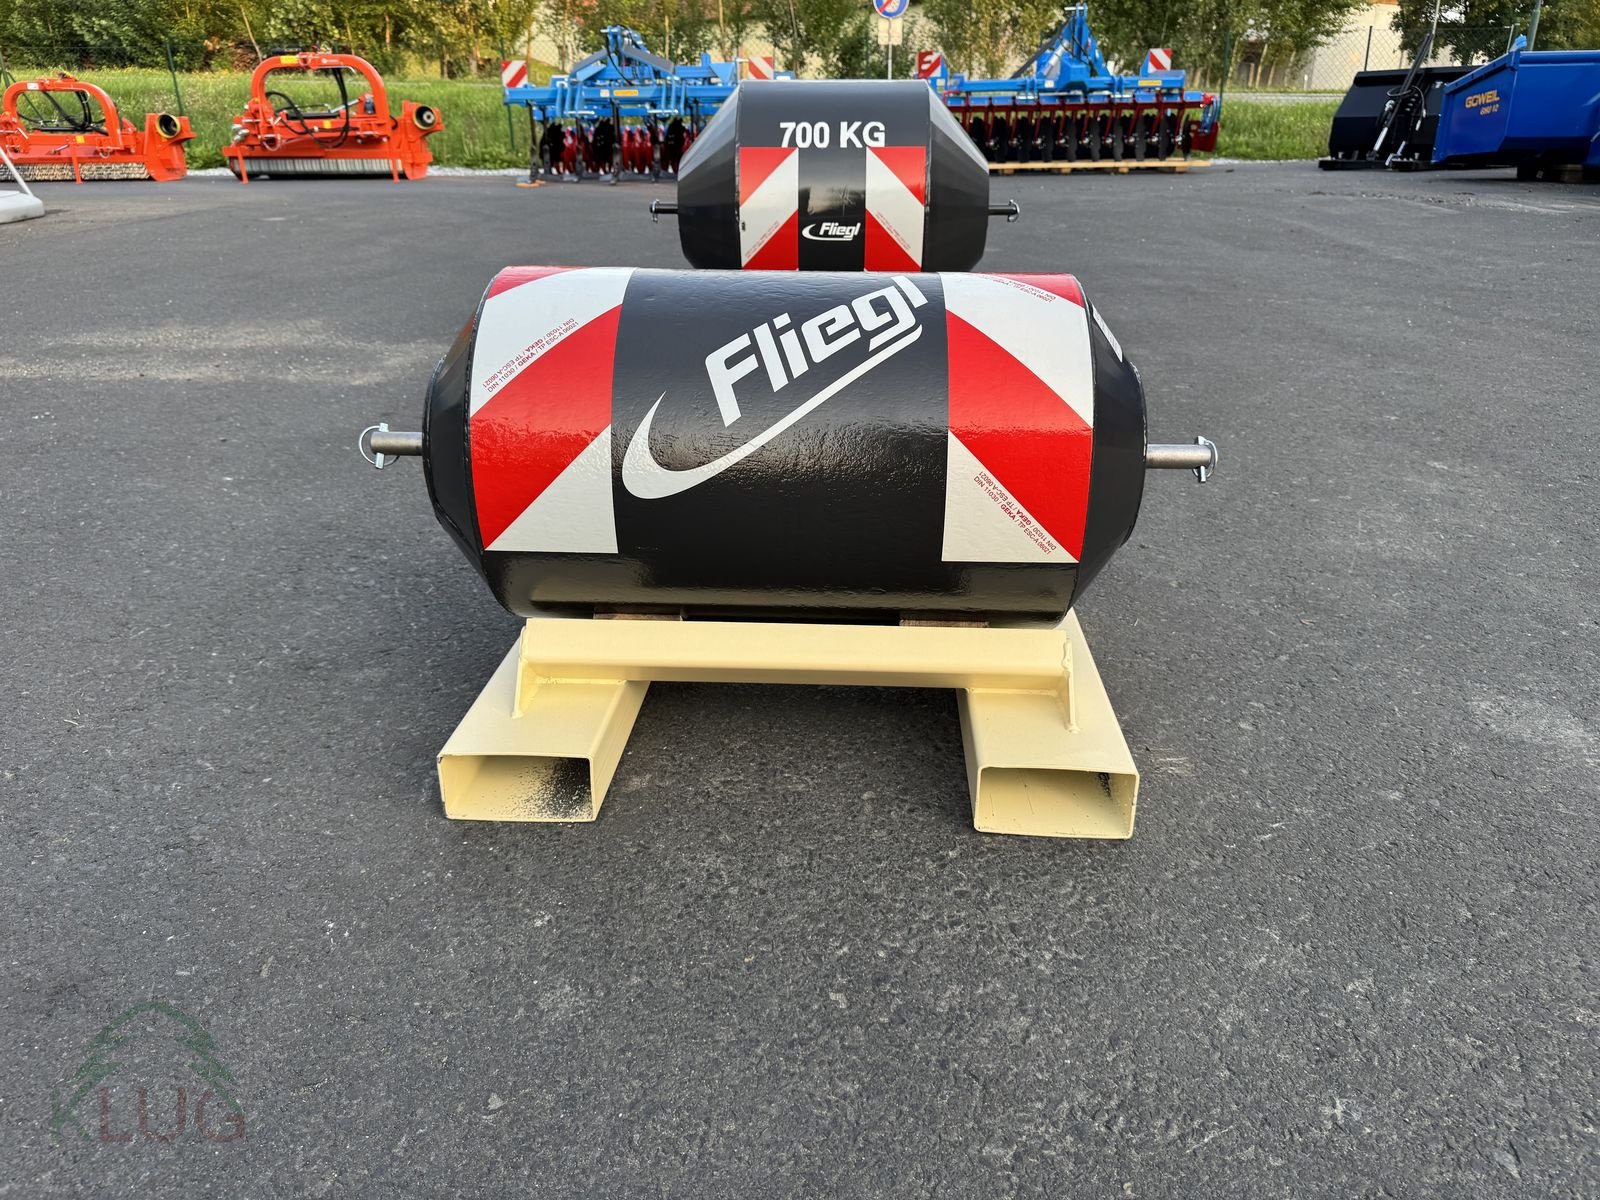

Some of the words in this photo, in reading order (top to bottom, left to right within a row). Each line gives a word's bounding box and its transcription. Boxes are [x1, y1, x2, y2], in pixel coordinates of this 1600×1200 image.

[780, 121, 830, 148] 700
[840, 121, 885, 148] KG
[819, 222, 861, 239] Fliegl
[705, 275, 928, 427] Fliegl
[974, 476, 985, 487] DIN
[1018, 521, 1026, 529] TP
